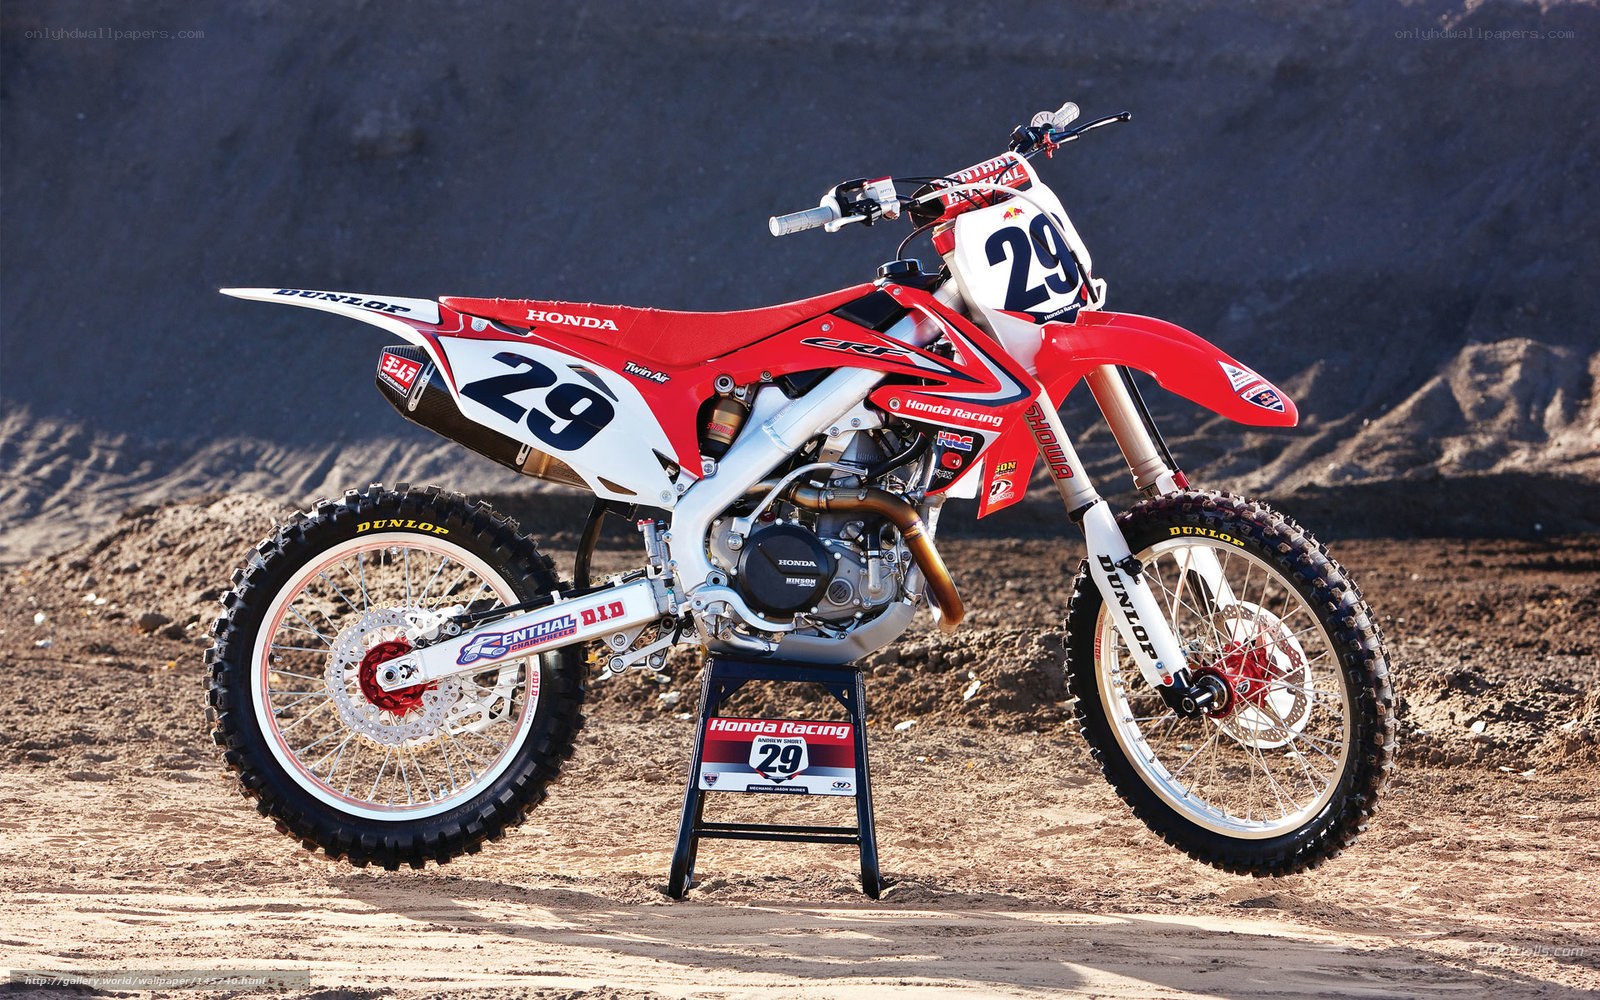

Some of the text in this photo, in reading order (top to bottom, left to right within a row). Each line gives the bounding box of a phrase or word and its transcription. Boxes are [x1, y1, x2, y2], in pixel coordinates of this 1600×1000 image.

[985, 212, 1079, 311] 29
[273, 289, 411, 313] DUNLOP
[526, 309, 619, 331] HONDA
[1044, 308, 1064, 320] Honda
[800, 337, 912, 356] CRF
[625, 361, 670, 383] Twin Air
[459, 352, 615, 451] 29
[905, 399, 1003, 427] Honda Racing
[936, 430, 974, 452] HRC
[1025, 401, 1074, 480] SHOWA
[356, 519, 449, 534] DUNLOP
[1169, 526, 1245, 547] DUNLOP
[778, 559, 817, 567] HONDA
[580, 601, 625, 626] D.I.D
[1096, 554, 1159, 660] DUNLOP
[511, 629, 575, 651] CHAINWHEELS
[709, 719, 851, 739] Honda Racing
[756, 743, 803, 774] 29
